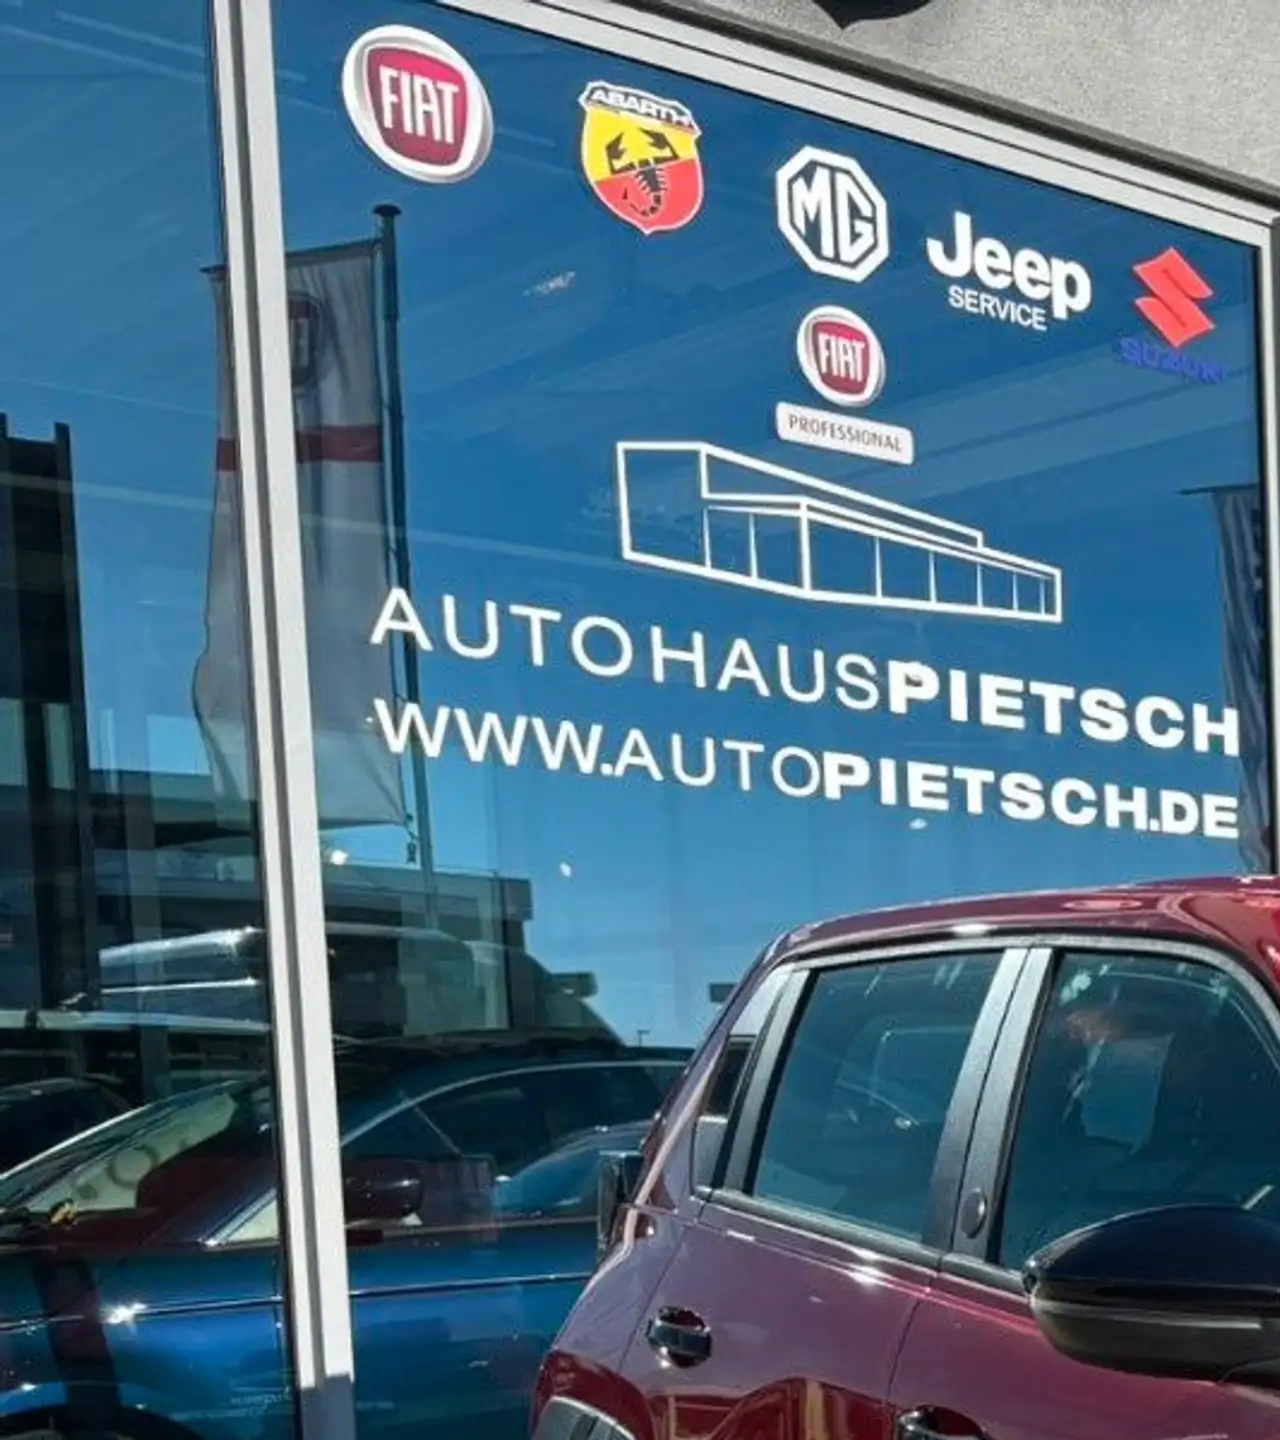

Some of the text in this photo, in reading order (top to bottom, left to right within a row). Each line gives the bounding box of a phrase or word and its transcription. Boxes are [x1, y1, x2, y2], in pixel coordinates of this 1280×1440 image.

[378, 65, 460, 145] FIAT
[590, 88, 695, 130] ABARTH
[790, 161, 878, 268] MG
[926, 211, 1092, 319] Jeep
[948, 285, 1048, 331] SERVICE
[818, 335, 867, 383] FIAT
[788, 413, 902, 452] PROFESSIONAL
[370, 588, 1240, 757] AUTOHAUSPIETSCH
[373, 698, 1240, 839] WWW.AUTOPIETSCH.DE
